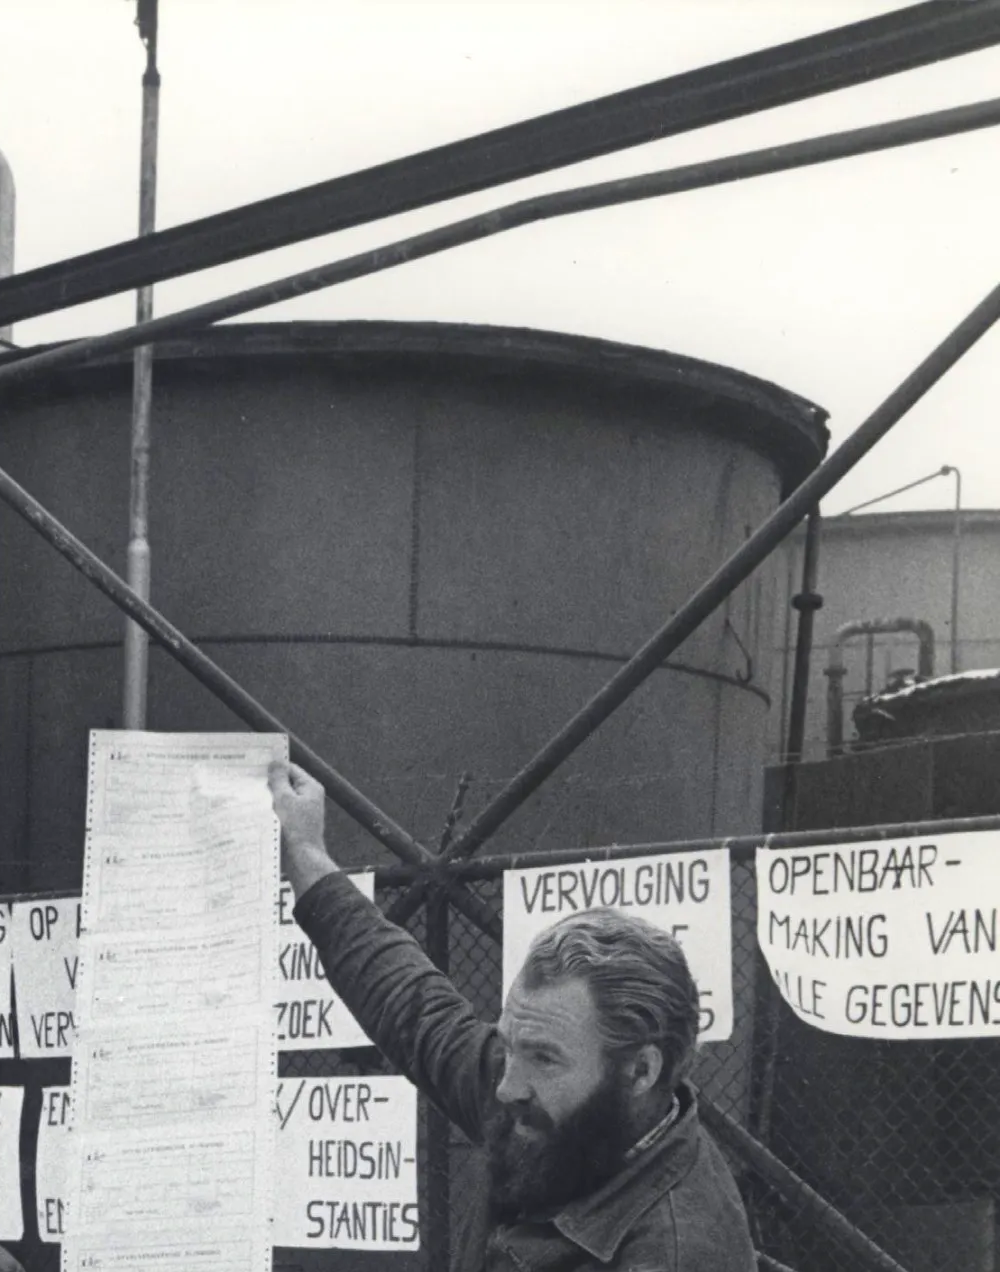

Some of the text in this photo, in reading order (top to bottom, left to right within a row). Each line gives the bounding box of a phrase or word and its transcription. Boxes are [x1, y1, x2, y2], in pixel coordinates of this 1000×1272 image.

[521, 859, 711, 914] VERVOLGING
[769, 845, 962, 895] OPENBAAR-
[29, 906, 58, 941] OP
[769, 907, 998, 959] MAKING VAN
